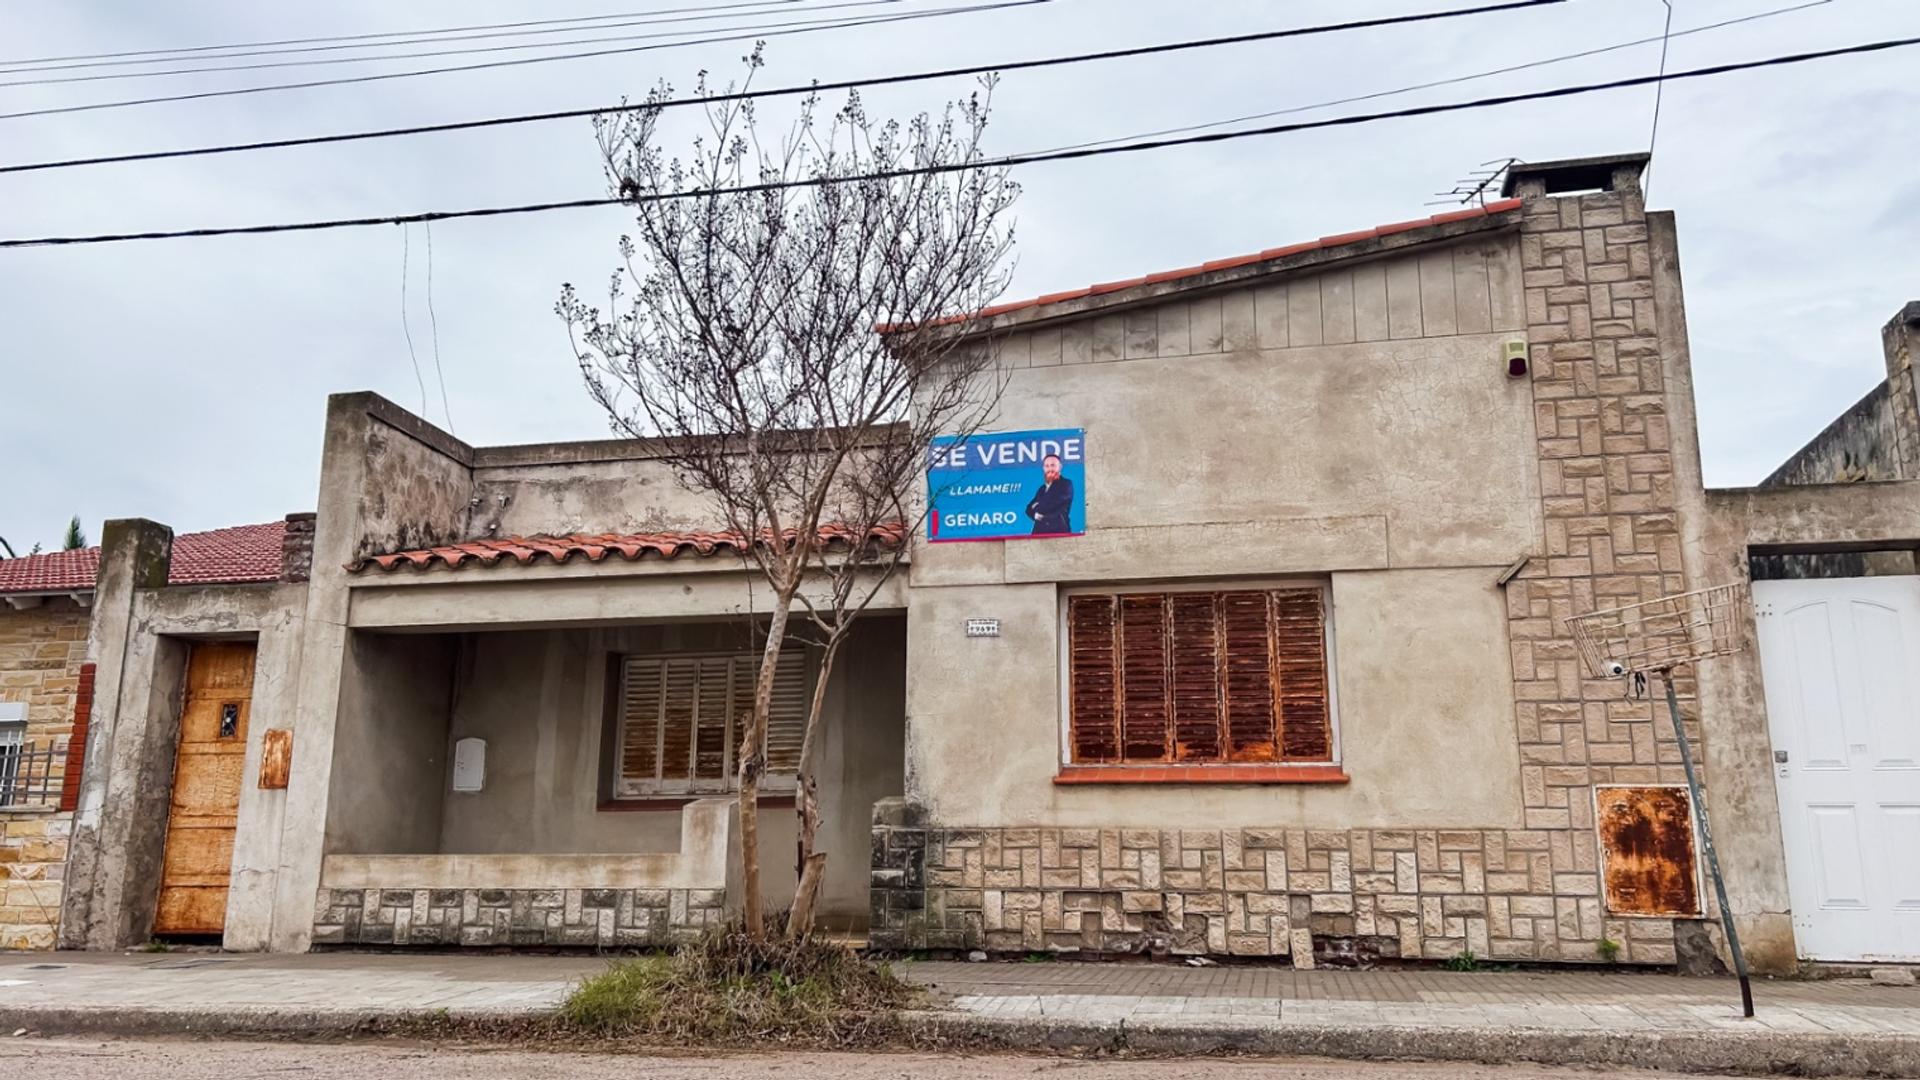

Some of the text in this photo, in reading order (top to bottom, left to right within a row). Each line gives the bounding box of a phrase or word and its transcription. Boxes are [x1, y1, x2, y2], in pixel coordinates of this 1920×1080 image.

[931, 439, 1080, 467] SE VENDE
[944, 511, 1017, 527] GENARO
